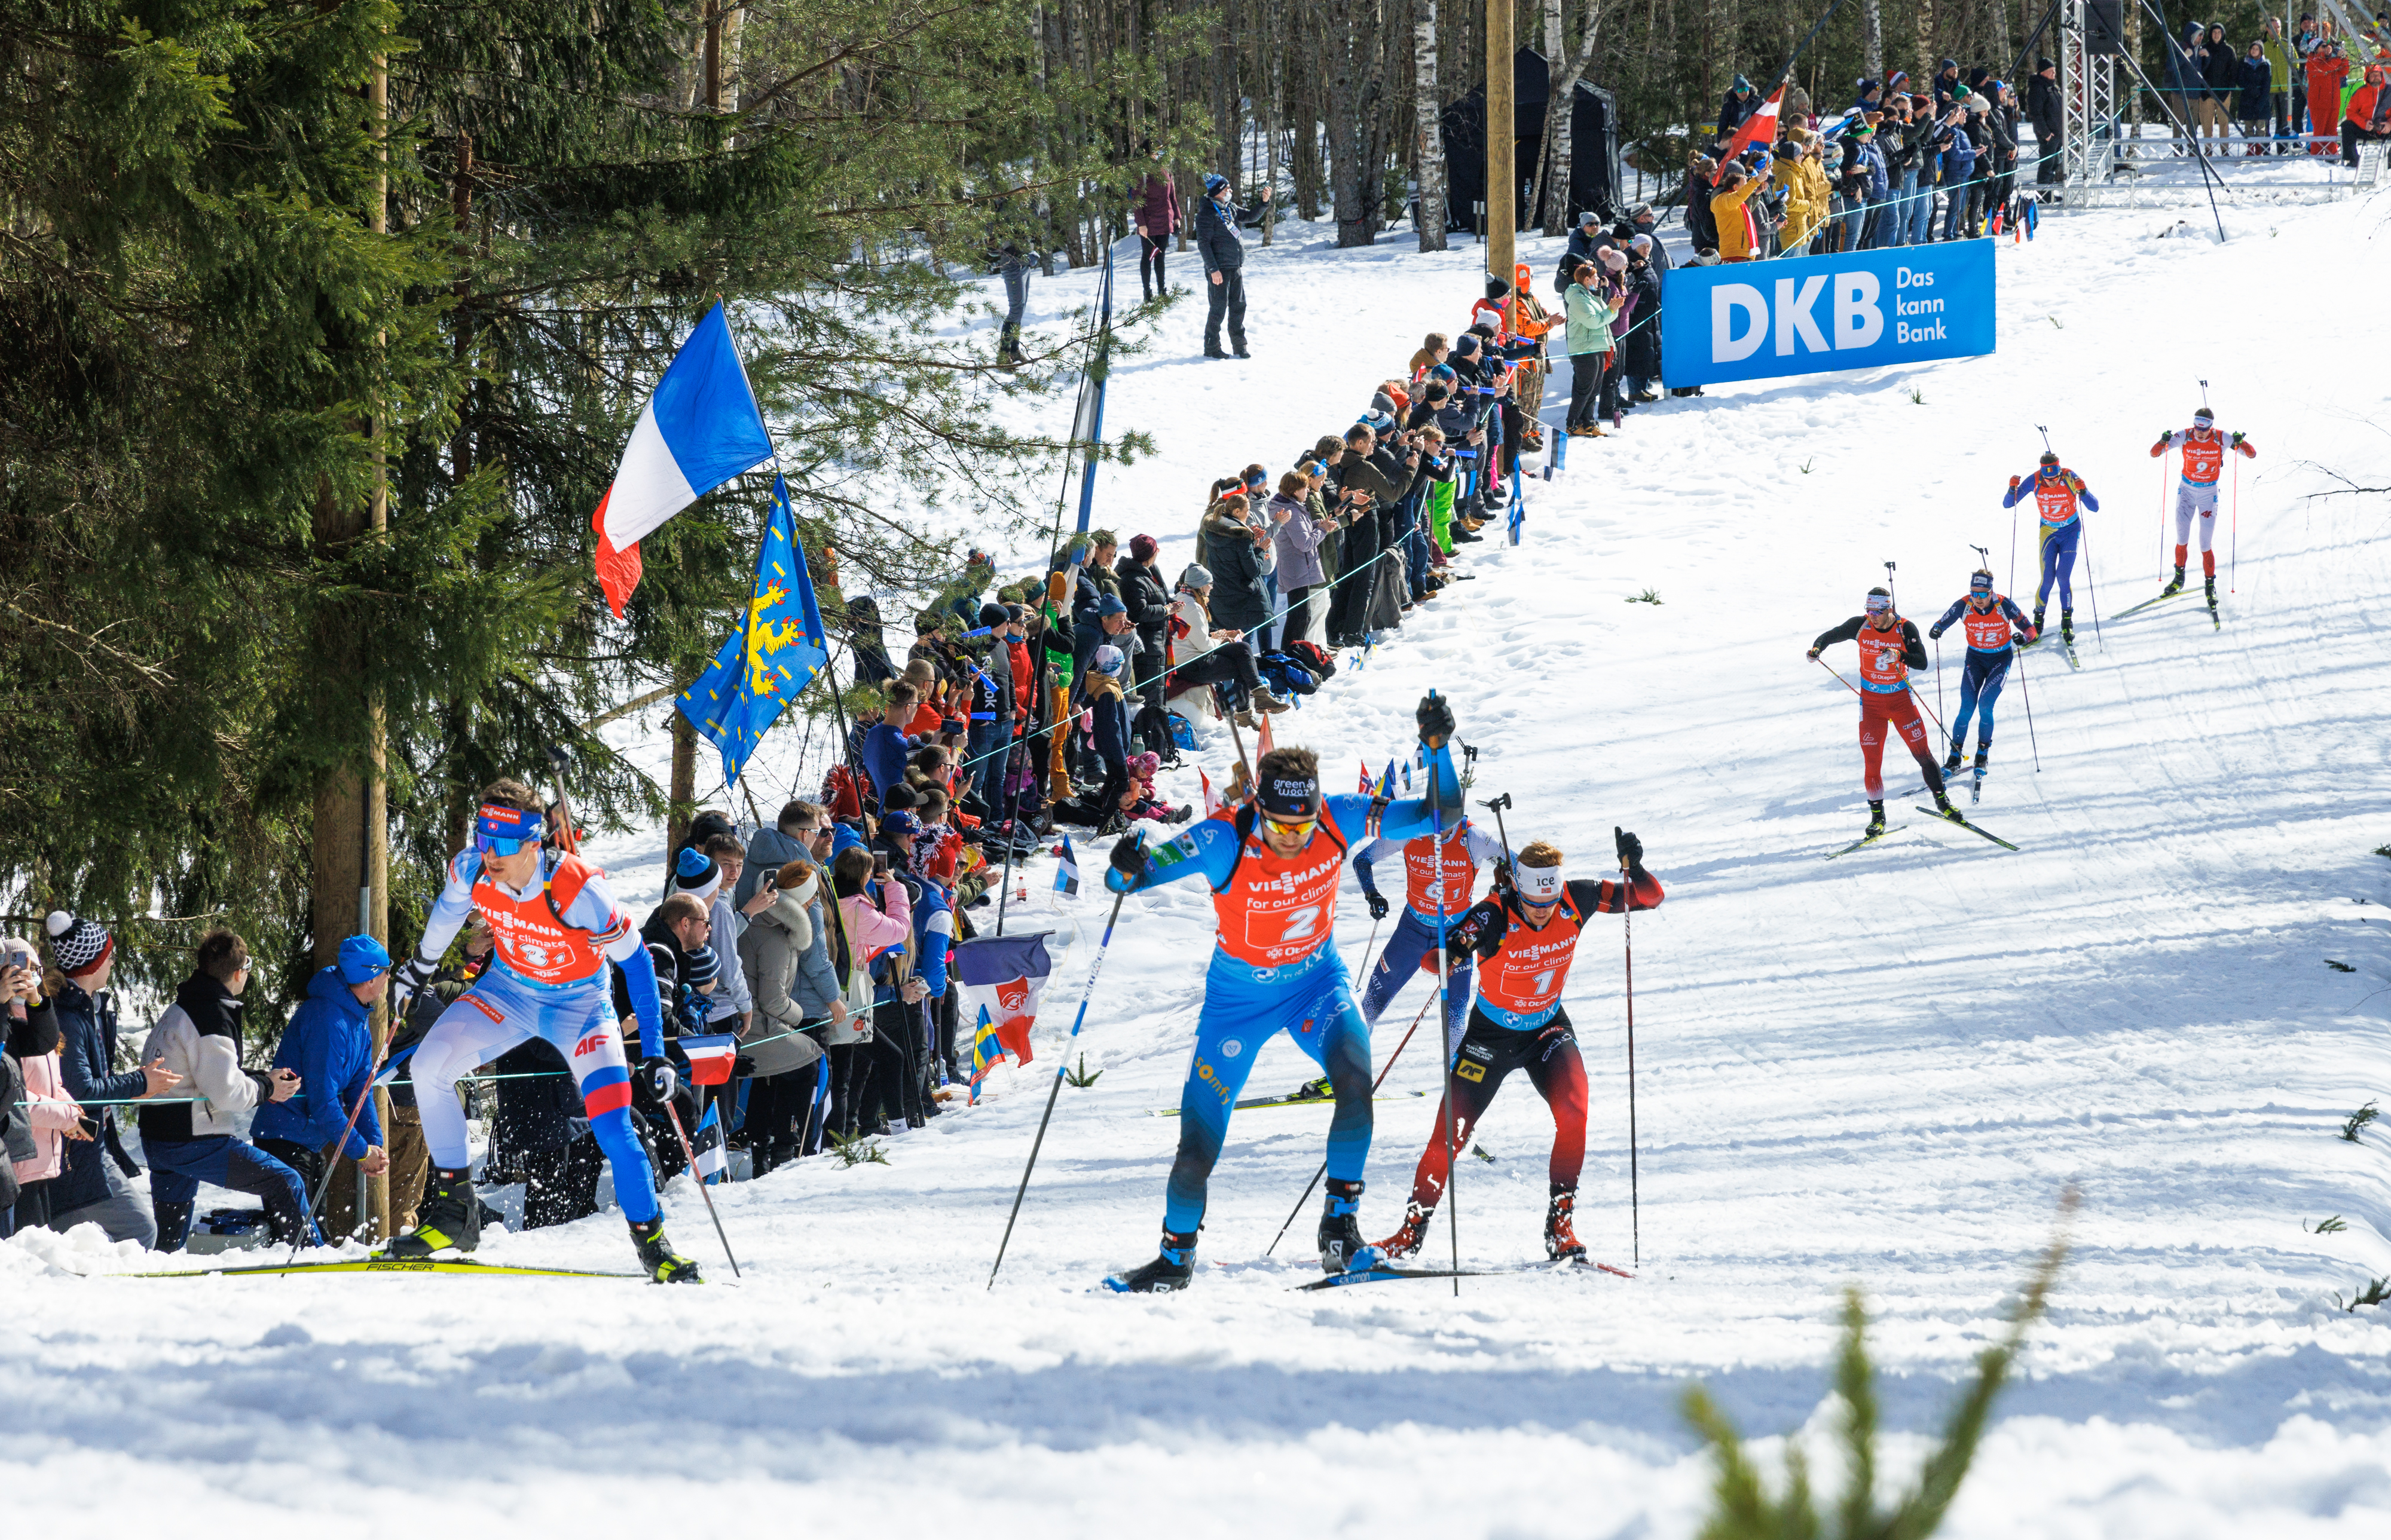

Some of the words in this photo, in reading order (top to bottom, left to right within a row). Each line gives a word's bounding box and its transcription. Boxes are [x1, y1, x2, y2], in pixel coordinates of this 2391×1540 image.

[1896, 267, 1934, 289] Das
[1896, 295, 1944, 316] kann
[1711, 271, 1884, 363] DKB
[1897, 318, 1947, 344] Bank
[2195, 461, 2208, 474] 9
[2041, 504, 2062, 515] 17
[1862, 639, 1901, 648] VIESSMANN
[1974, 632, 1997, 642] 12
[1875, 656, 1889, 672] 8
[1981, 673, 2004, 696] RAIFFEISEN
[1273, 779, 1305, 791] green
[1278, 788, 1310, 797] weez
[481, 807, 519, 820] VIESSMANN
[1409, 854, 1466, 868] VIESSANN
[1434, 834, 1444, 904] SALOMON
[1248, 851, 1341, 895] VIESSMANN
[1536, 875, 1555, 886] ice
[1424, 880, 1447, 899] 6
[1453, 888, 1461, 899] 1
[1247, 898, 1269, 909] for
[1273, 897, 1299, 908] our
[477, 901, 563, 936] VIESSMANN
[1280, 905, 1321, 942] 2
[495, 926, 516, 938] our
[518, 934, 567, 947] climate
[1508, 934, 1577, 962] VIESSMANN
[1504, 962, 1521, 971] for
[1523, 962, 1541, 970] our
[1532, 968, 1557, 996] 1
[1524, 1018, 1541, 1028] THE
[1541, 1005, 1555, 1024] iX
[372, 1041, 388, 1076] SWIX
[1466, 1043, 1493, 1058] HURTIGRUTA
[1466, 1048, 1491, 1061] CARGLASS
[1194, 1056, 1231, 1106] somfy
[366, 1262, 435, 1272] FISCHER
